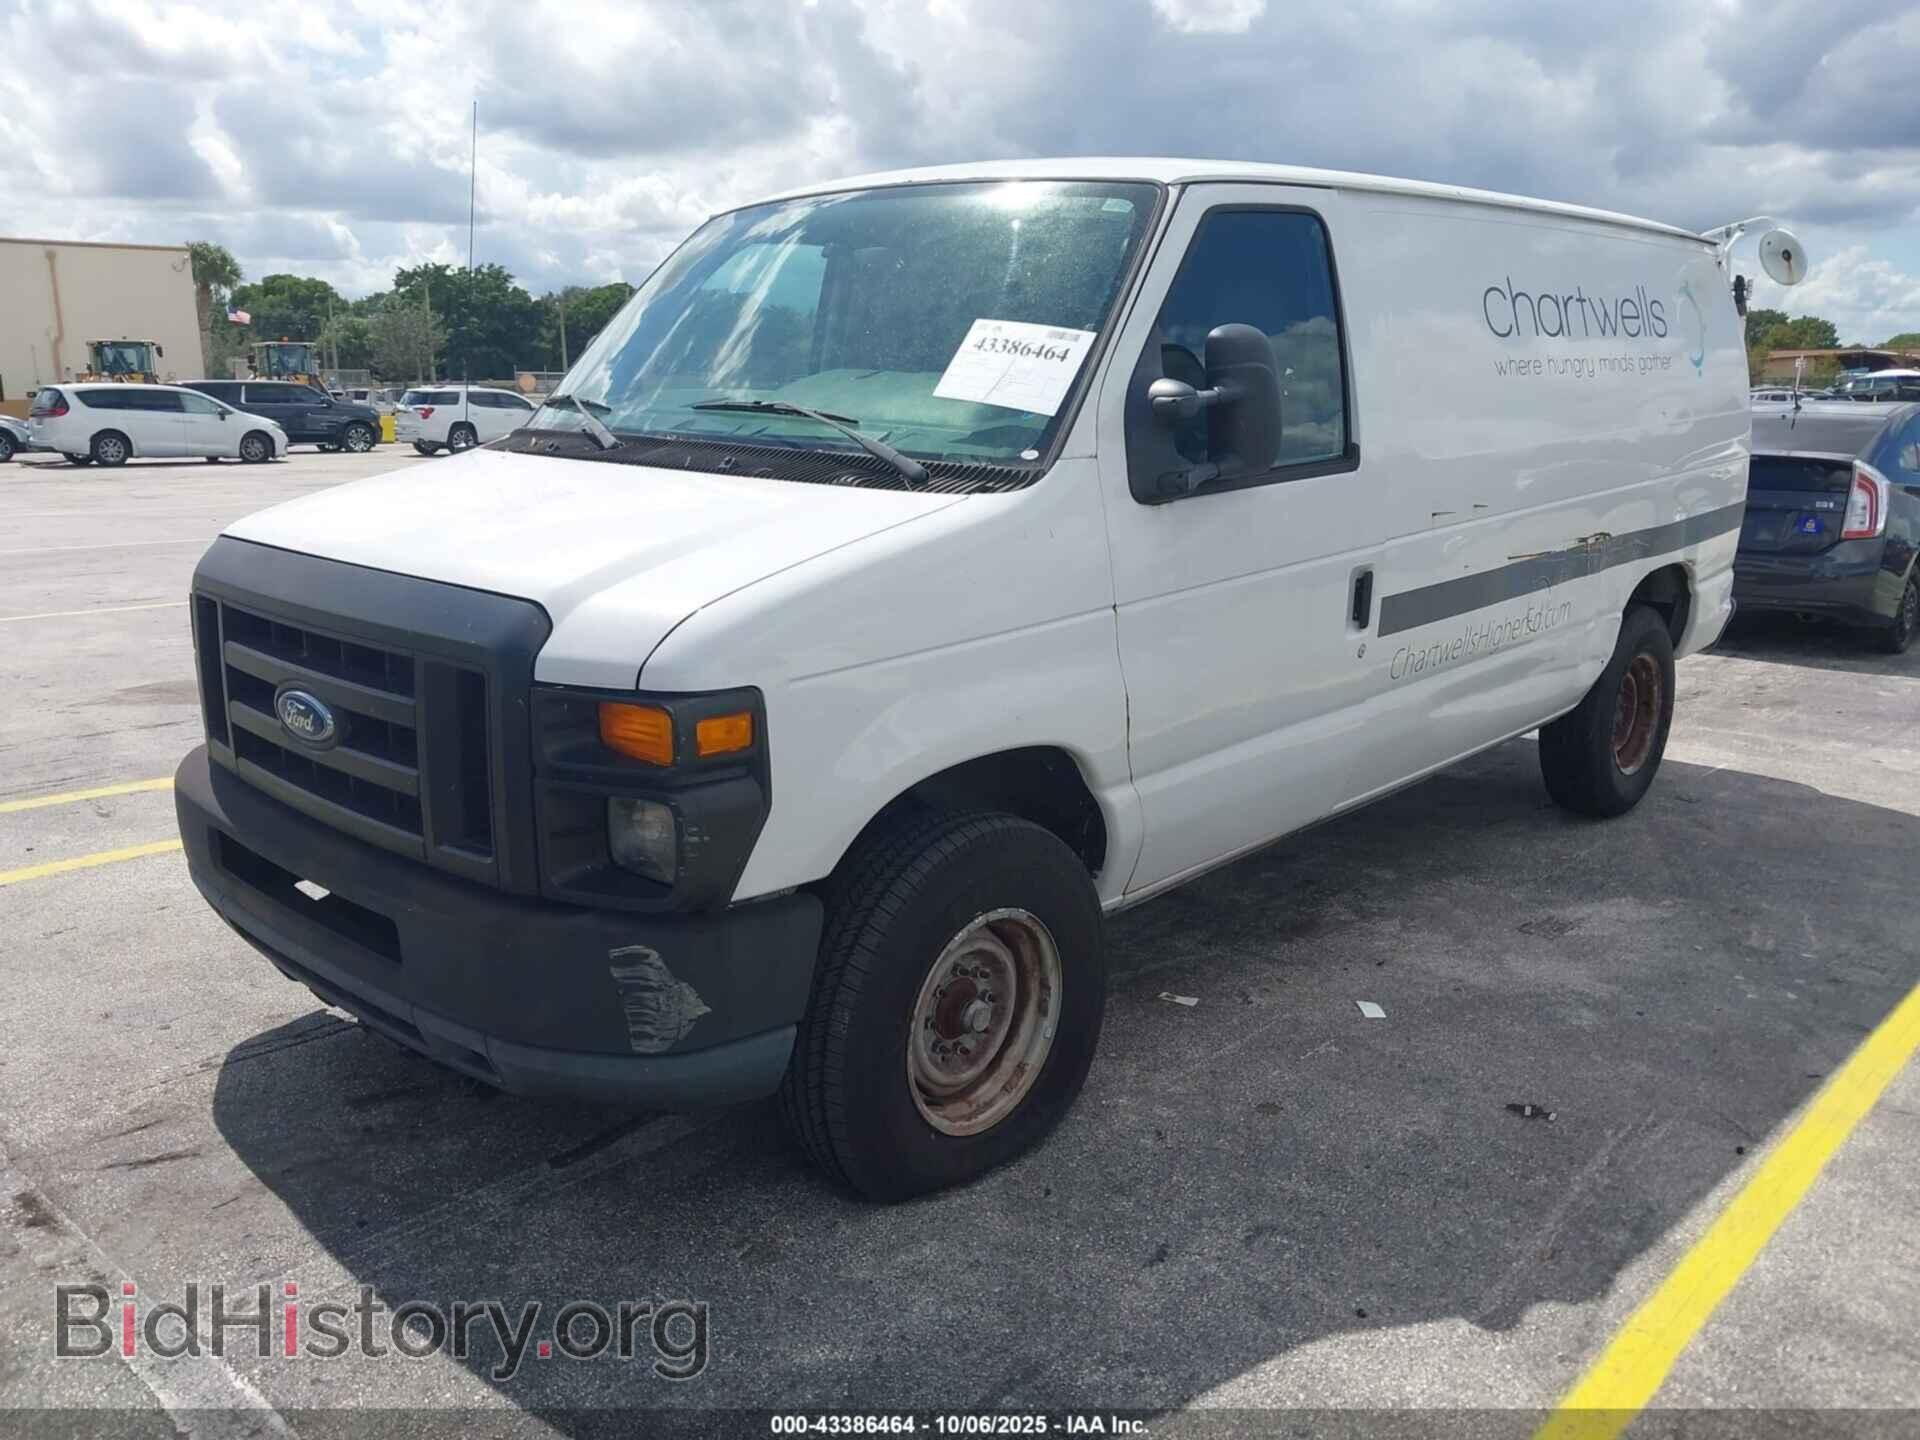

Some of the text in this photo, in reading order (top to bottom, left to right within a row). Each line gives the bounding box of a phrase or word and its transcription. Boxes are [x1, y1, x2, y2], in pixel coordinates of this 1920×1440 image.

[1483, 276, 1668, 338] chartwells
[974, 337, 1070, 362] 43386464
[1494, 355, 1542, 377] where
[1547, 354, 1595, 378] hungry
[1600, 353, 1634, 372] minds
[285, 700, 314, 732] Ford
